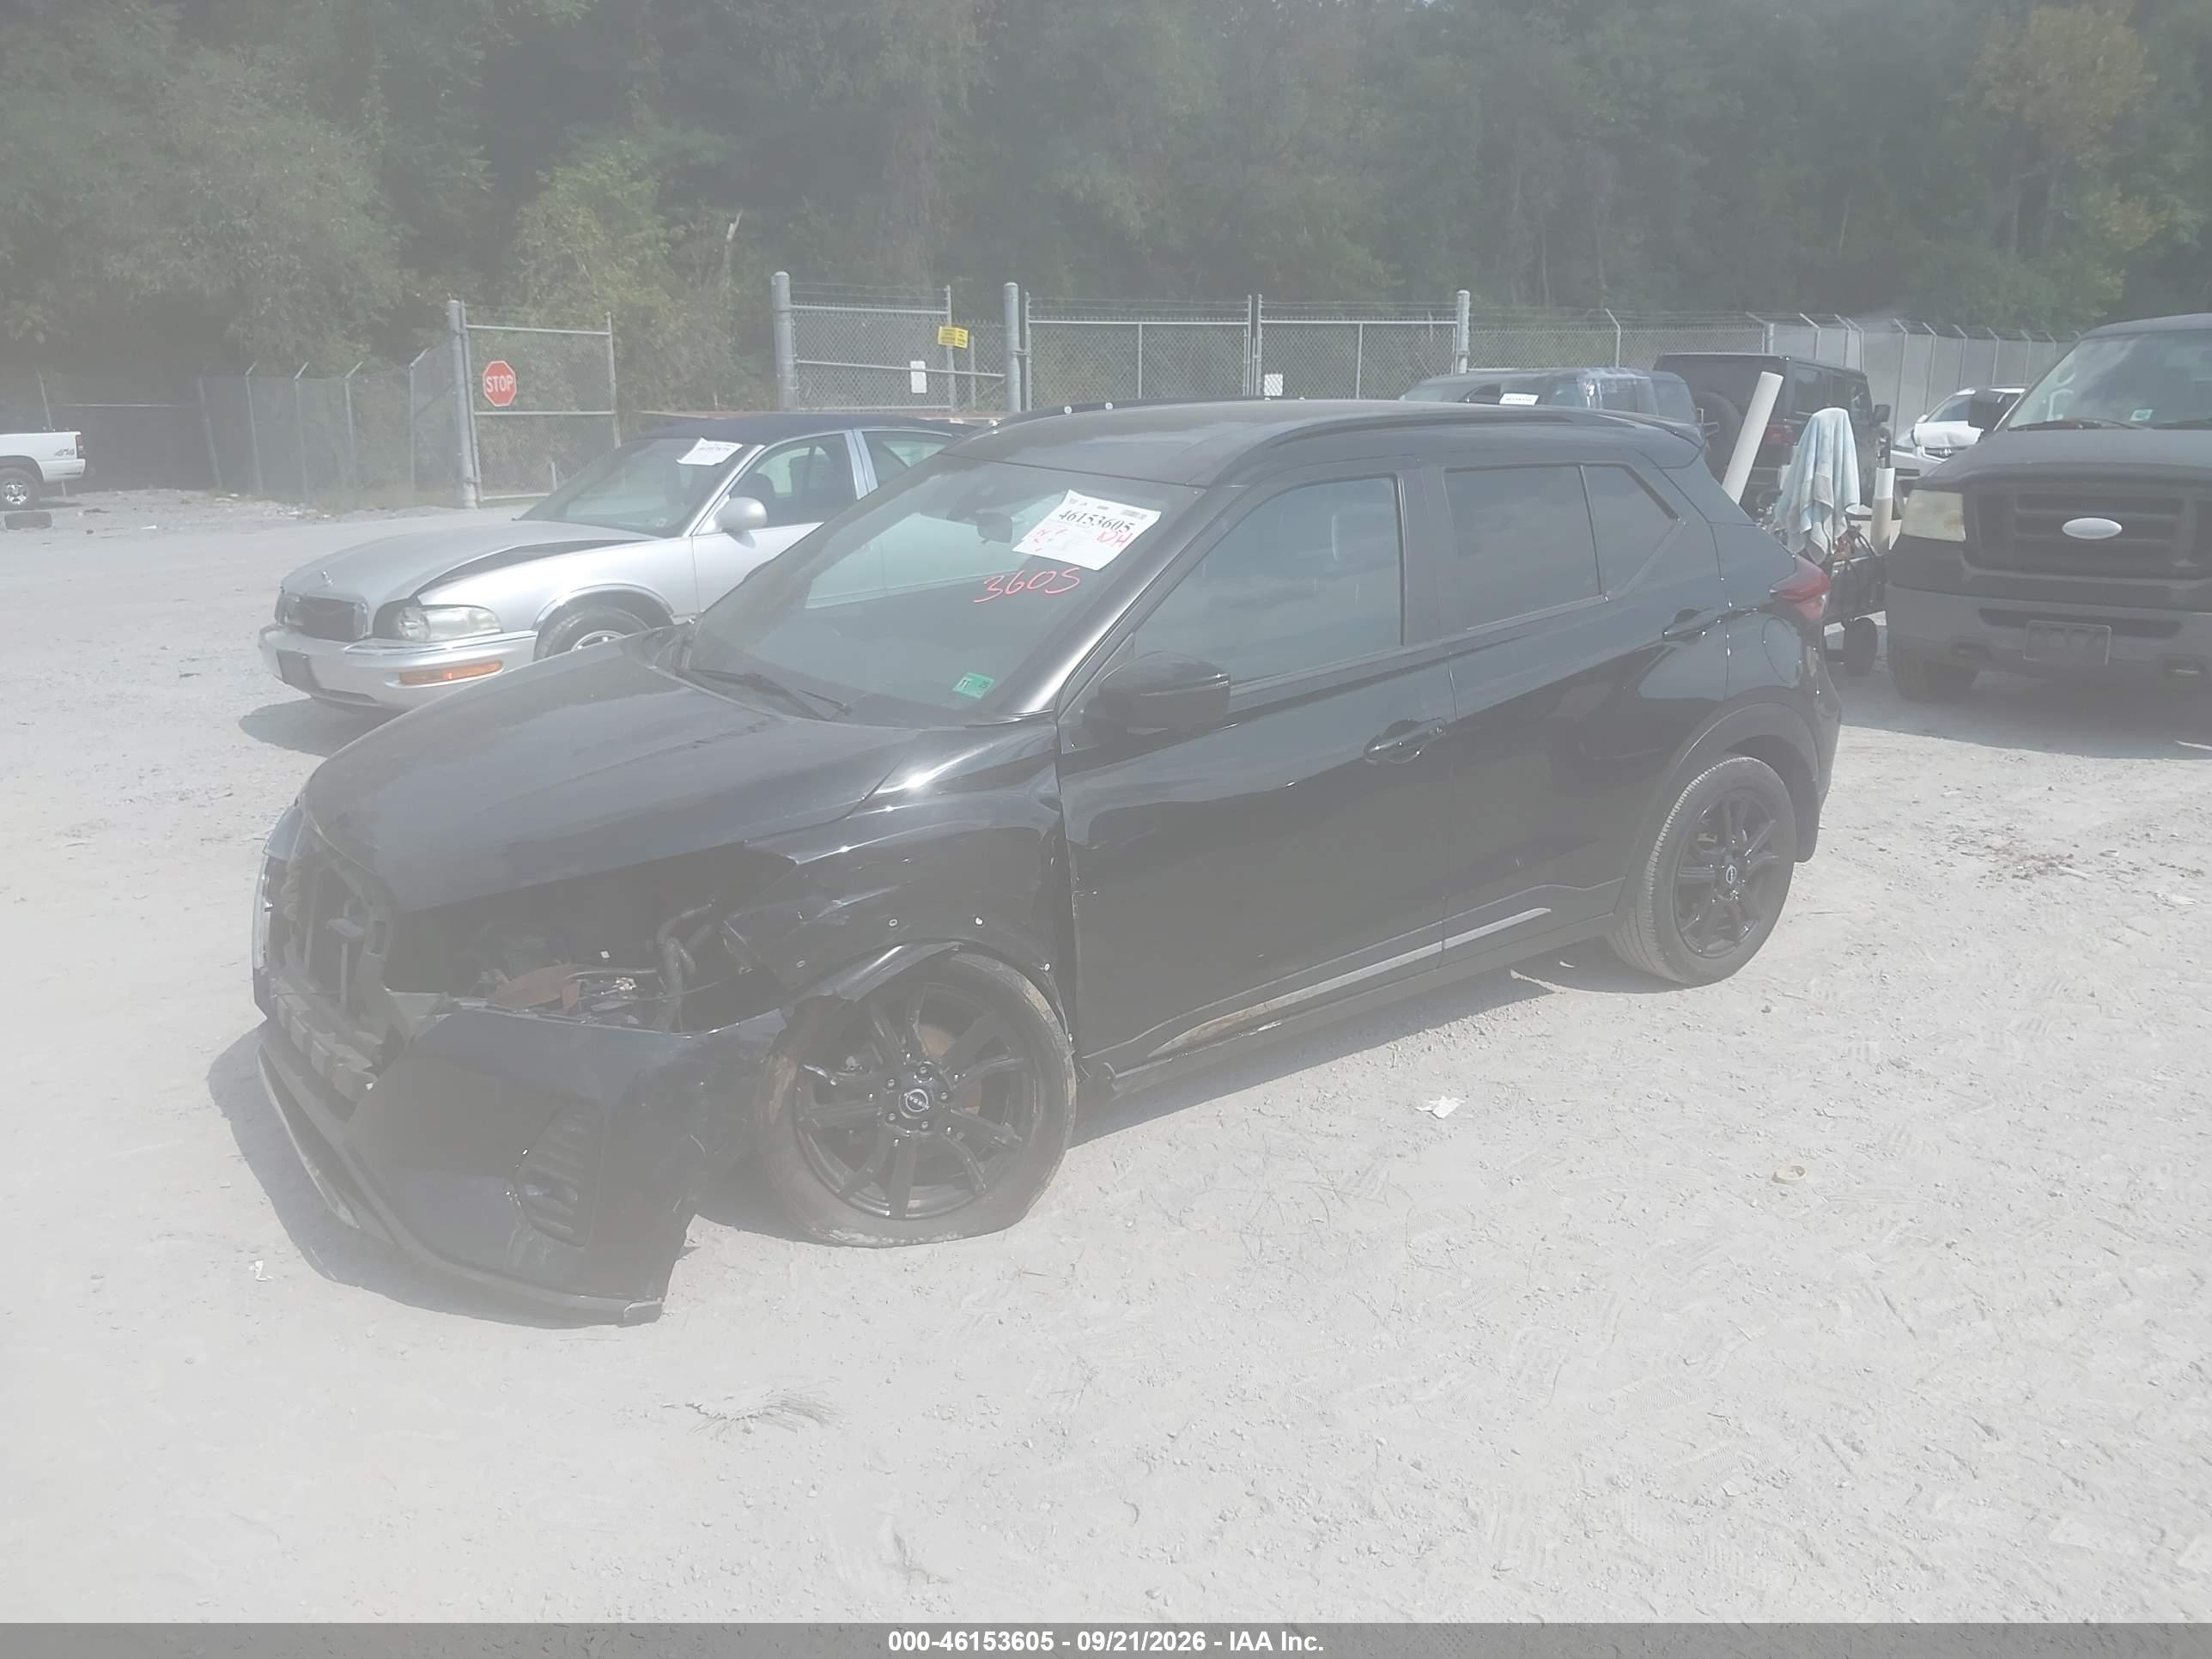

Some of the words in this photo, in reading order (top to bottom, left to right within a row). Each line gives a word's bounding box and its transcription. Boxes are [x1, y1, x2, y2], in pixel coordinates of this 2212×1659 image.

[486, 374, 513, 392] STOP
[1059, 508, 1135, 533] 46153605
[973, 566, 1081, 604] 3605
